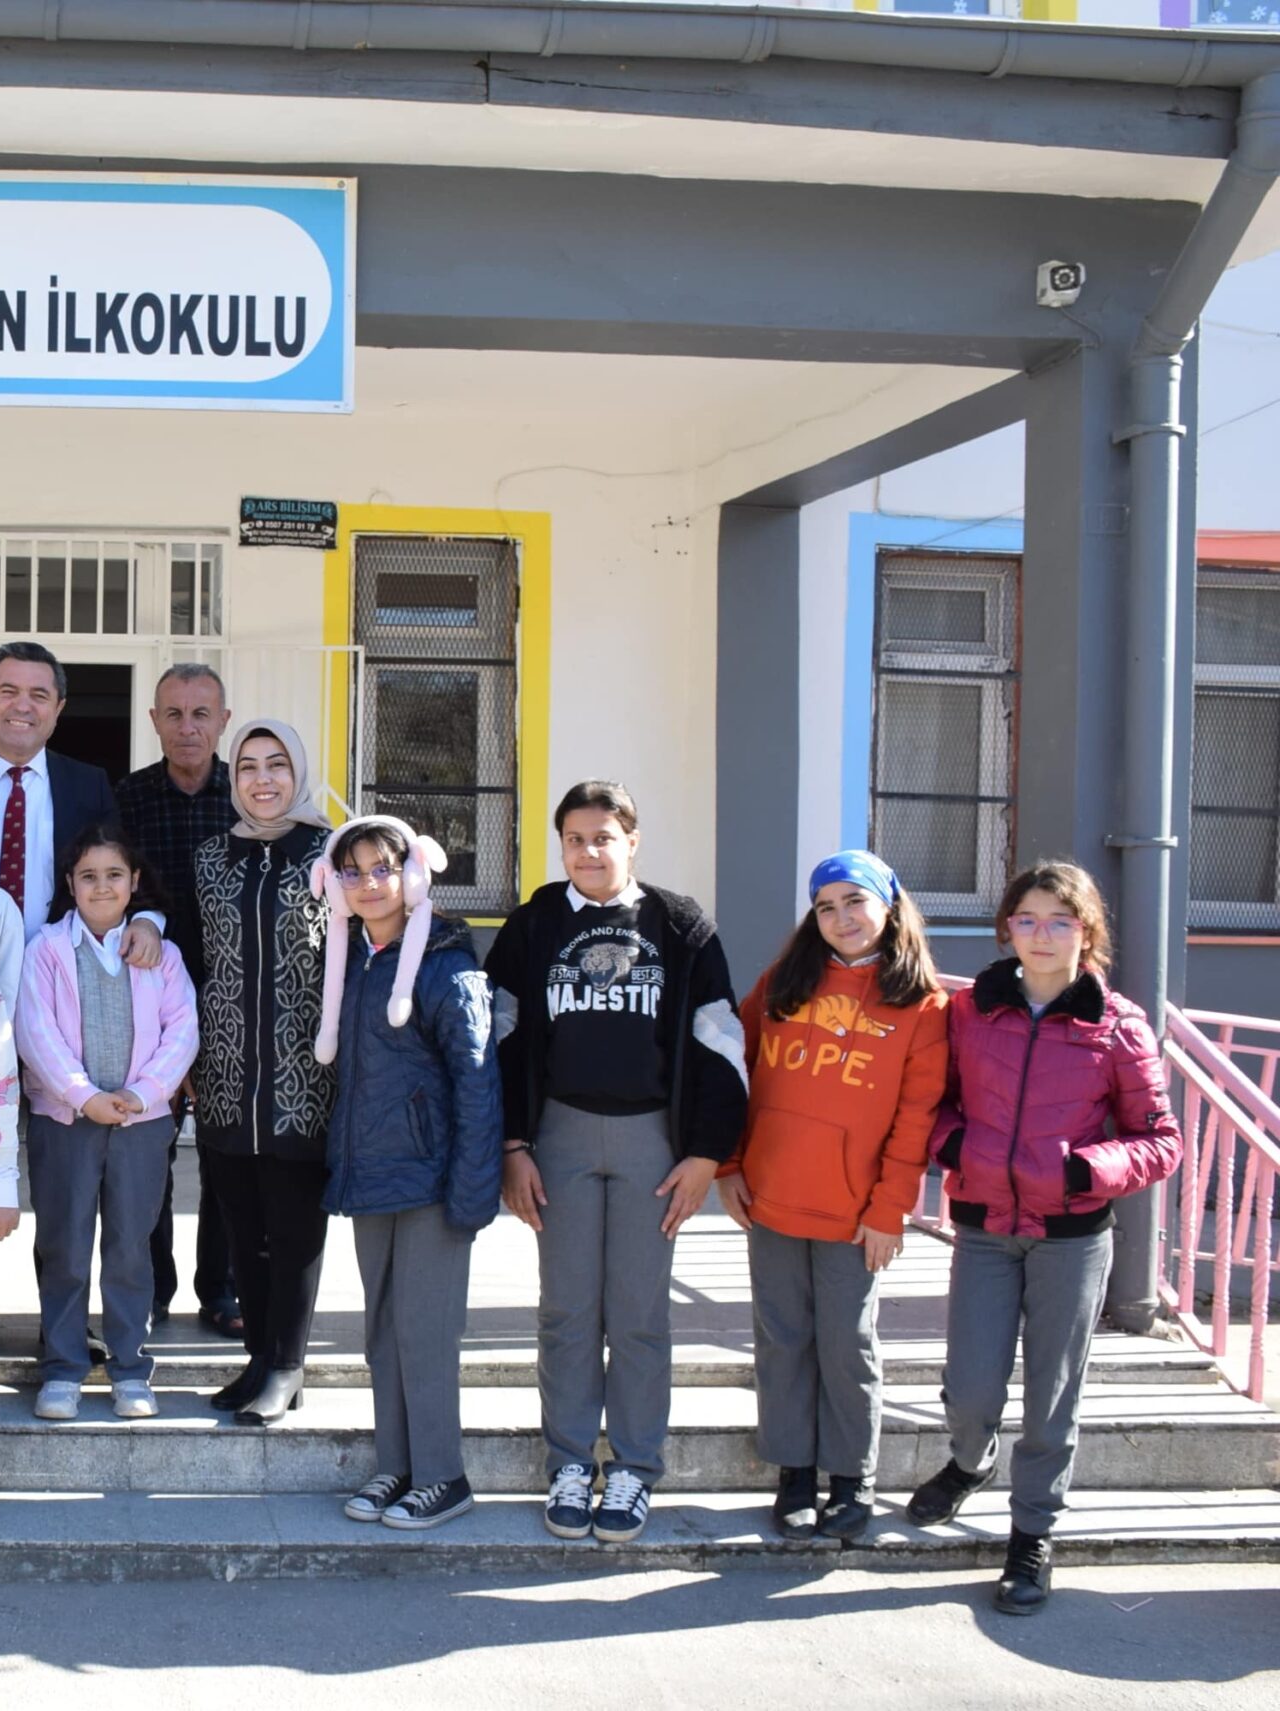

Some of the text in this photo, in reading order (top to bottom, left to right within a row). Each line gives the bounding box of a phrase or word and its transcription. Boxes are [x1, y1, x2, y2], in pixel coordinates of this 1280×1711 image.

[47, 274, 307, 358] İLKOKULU
[256, 501, 322, 514] ARS BİLİŞİM
[559, 926, 660, 960] STRONG AND ENERGETIC
[557, 967, 581, 981] STATE
[631, 969, 651, 981] BEST
[761, 1031, 875, 1090] NOPE.
